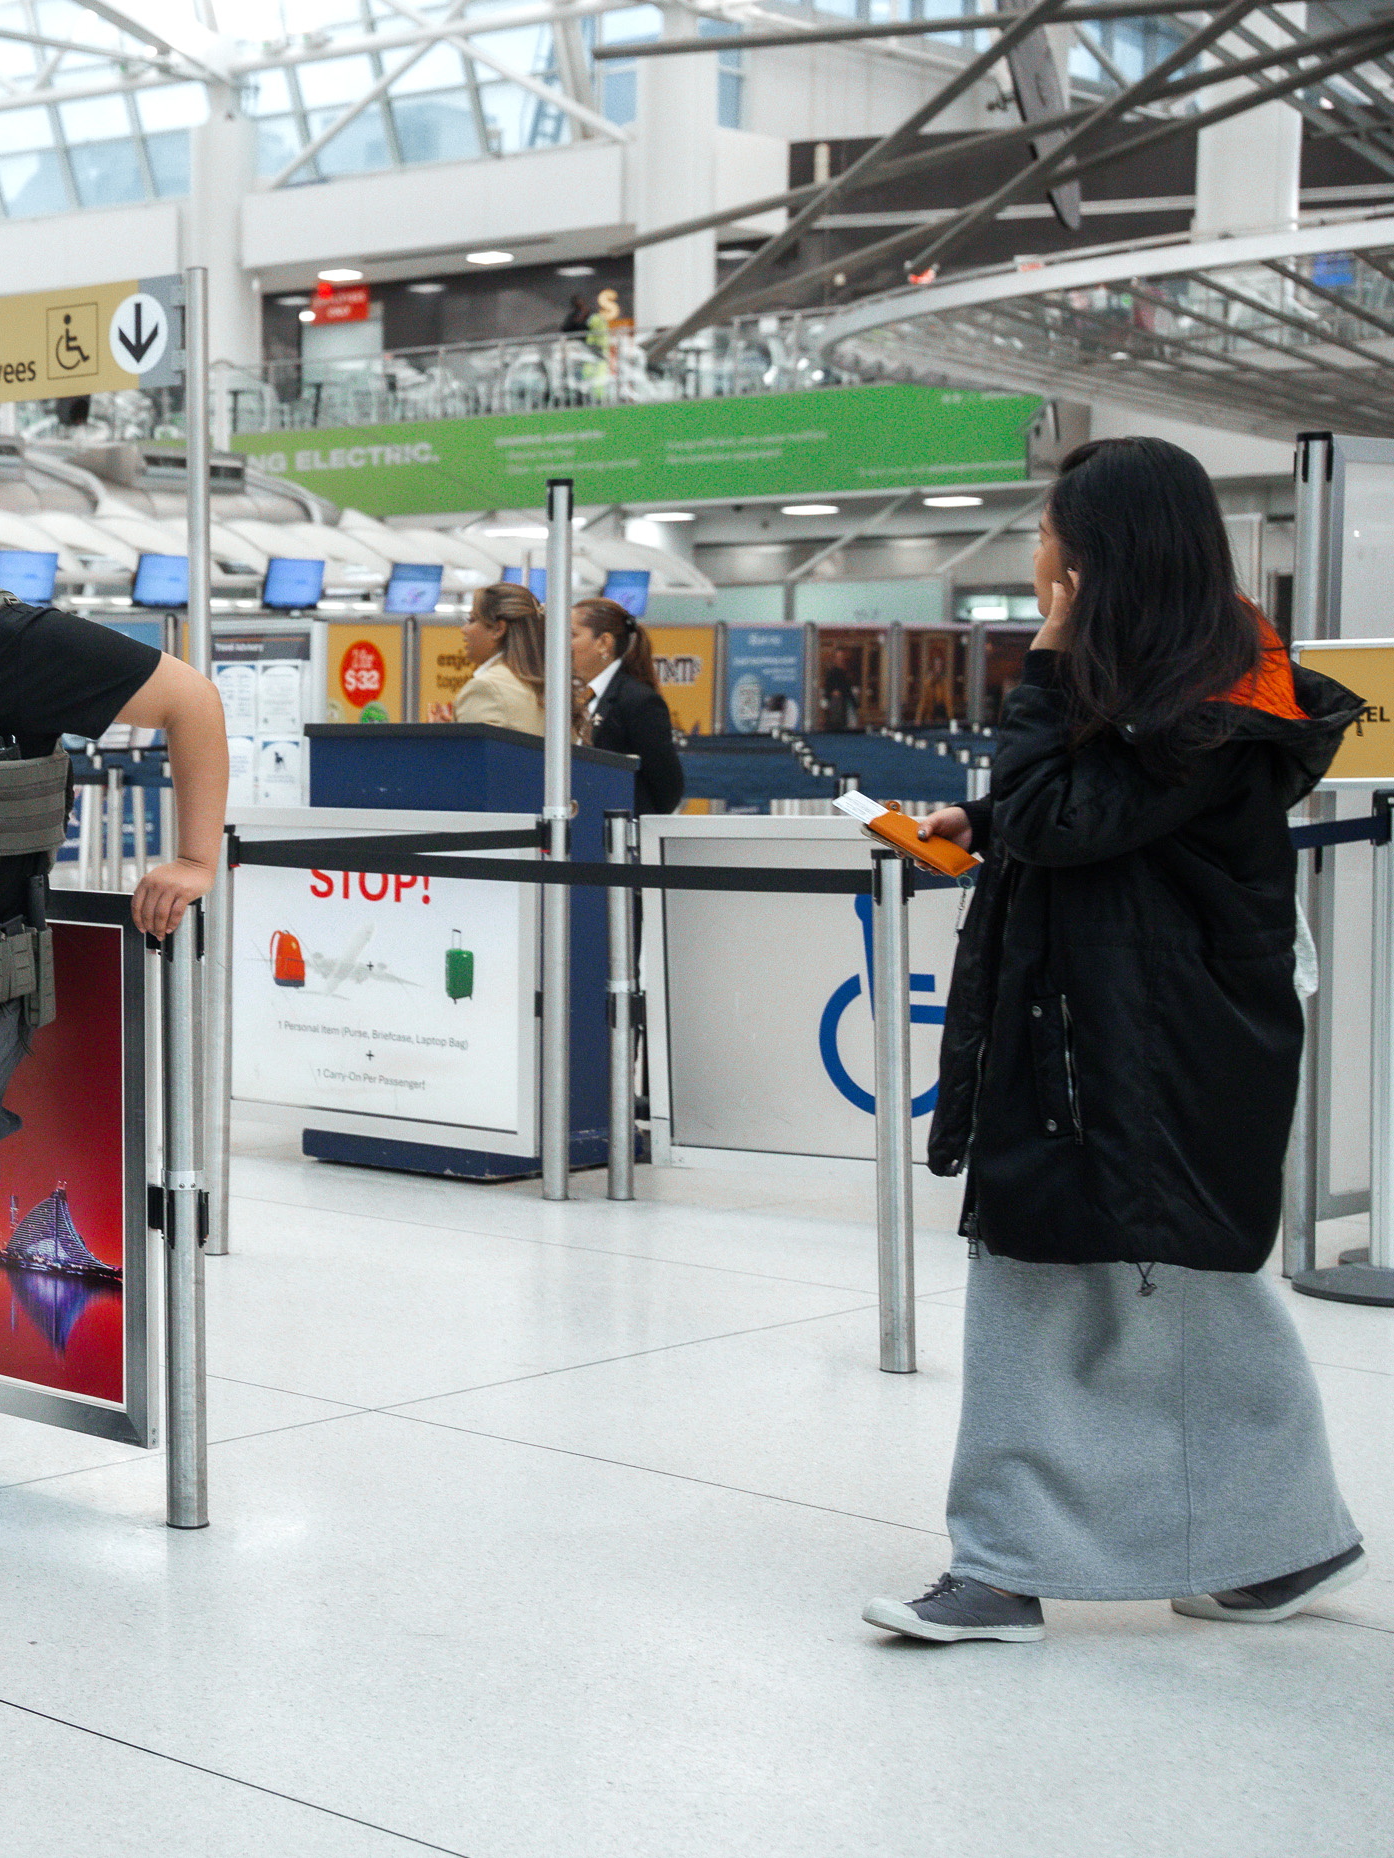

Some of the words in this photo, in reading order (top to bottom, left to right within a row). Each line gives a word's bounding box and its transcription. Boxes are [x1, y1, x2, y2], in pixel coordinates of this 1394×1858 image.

[295, 442, 440, 471] ELECTRIC.
[344, 669, 380, 692] $32
[284, 1021, 319, 1033] Personal
[321, 1025, 340, 1035] Item
[342, 1027, 370, 1039] (Purse,
[372, 1030, 414, 1044] Briefcase,
[416, 1034, 447, 1047] Laptop
[448, 1038, 468, 1050] Bag)
[323, 1069, 361, 1082] Carry-On
[363, 1073, 377, 1083] Per
